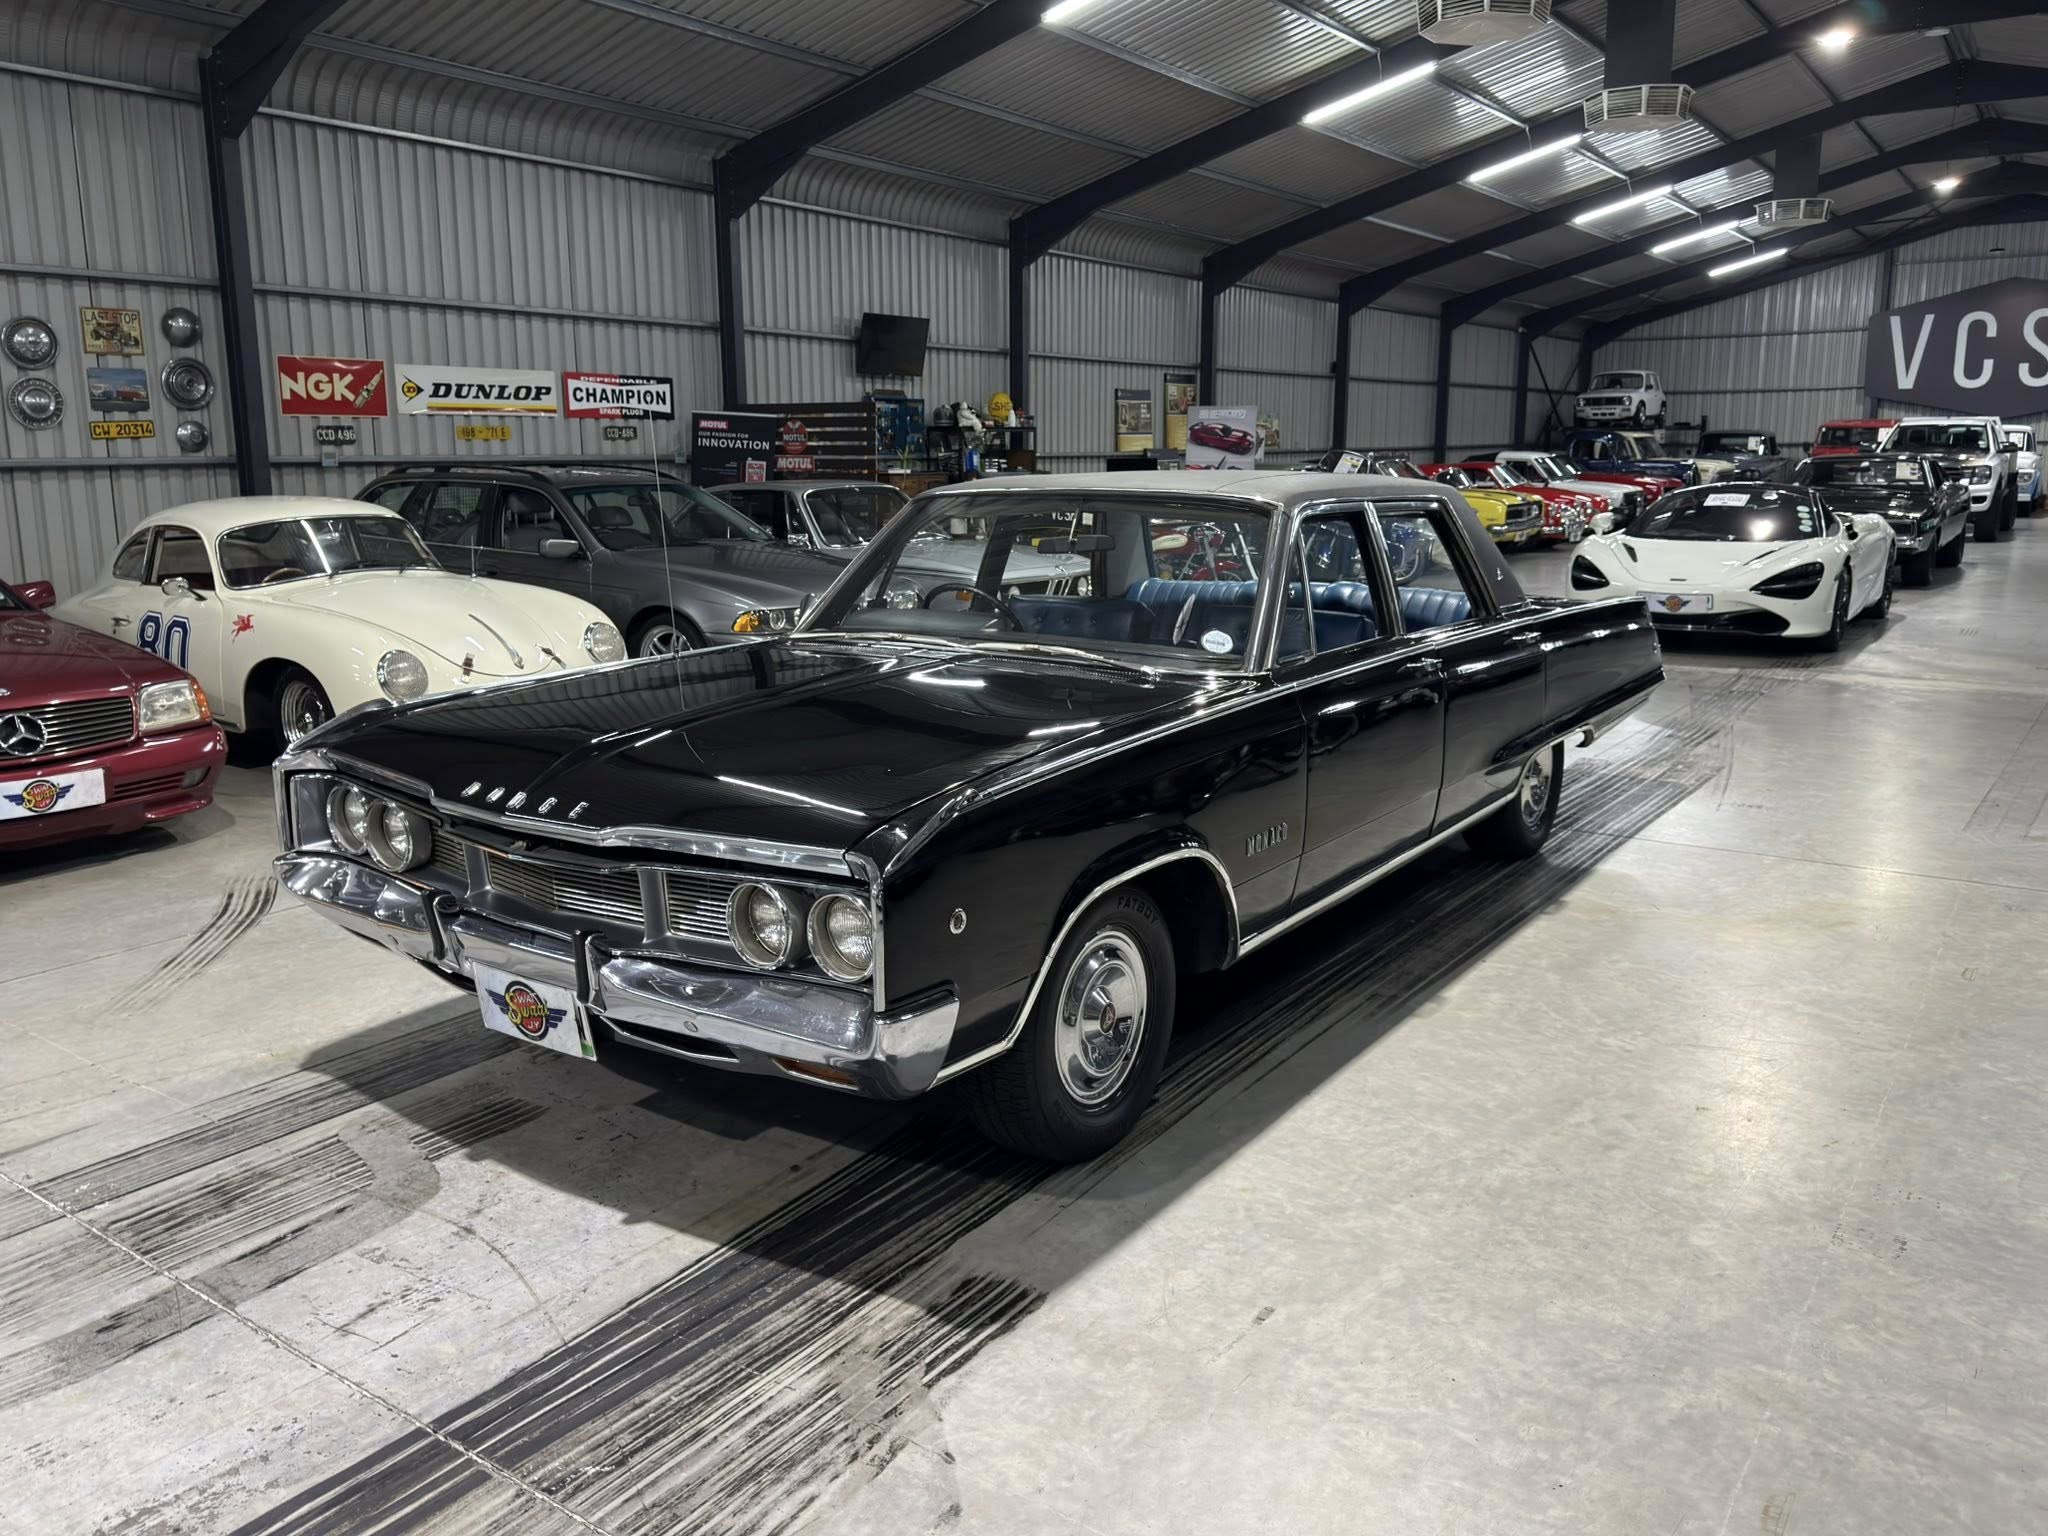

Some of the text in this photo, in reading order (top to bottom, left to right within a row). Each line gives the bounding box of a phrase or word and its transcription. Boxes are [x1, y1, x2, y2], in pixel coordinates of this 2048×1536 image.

[83, 311, 138, 324] LAST STOP
[1890, 308, 2048, 389] VCS
[280, 371, 357, 402] NGK
[580, 376, 657, 385] DEPENDABLE
[428, 382, 553, 401] DUNLOP
[572, 387, 667, 406] CHAMPION
[622, 408, 644, 416] PLUGS
[93, 423, 153, 436] CW 20314
[699, 420, 728, 429] MOTUL
[337, 429, 357, 441] 496
[783, 433, 806, 441] MOTUL
[698, 437, 770, 450] INNOVATION
[777, 457, 813, 469] MOTUL
[1247, 821, 1288, 857] MONACO
